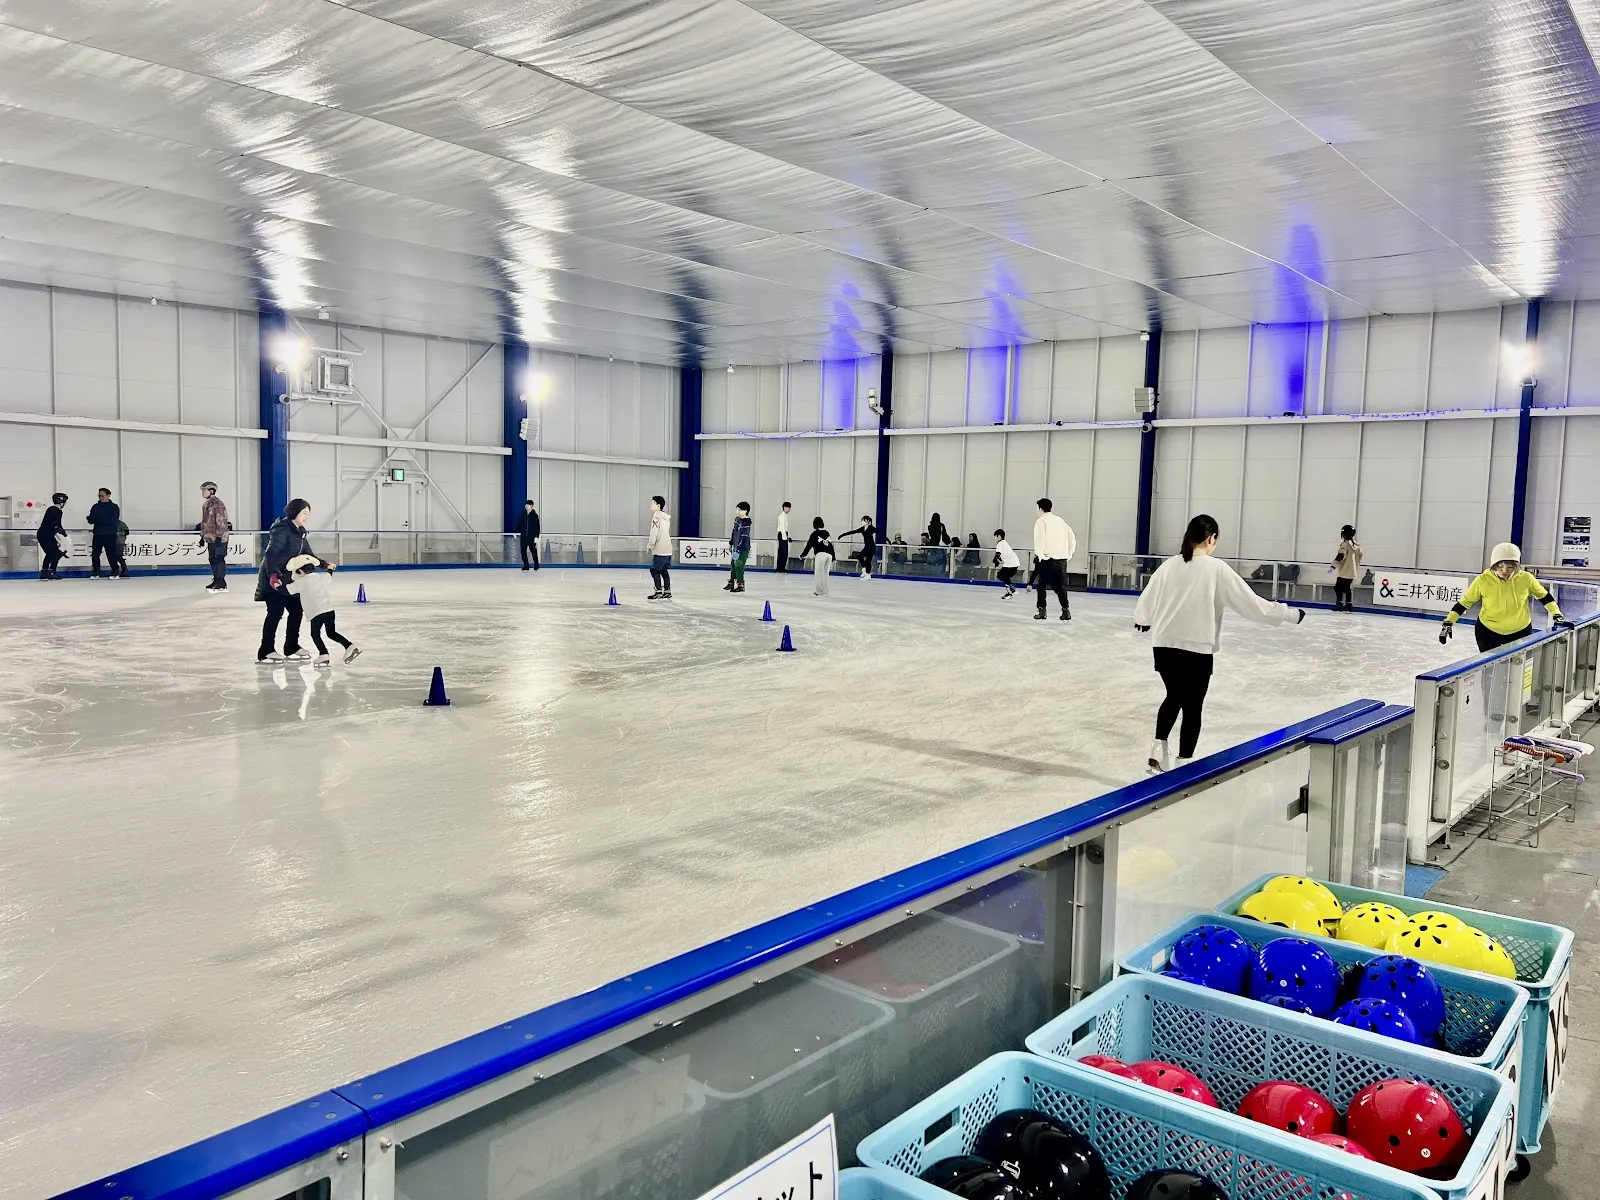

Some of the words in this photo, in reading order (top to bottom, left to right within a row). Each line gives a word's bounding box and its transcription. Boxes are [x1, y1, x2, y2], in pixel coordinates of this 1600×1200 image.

[1397, 582, 1463, 602] 三井不動産
